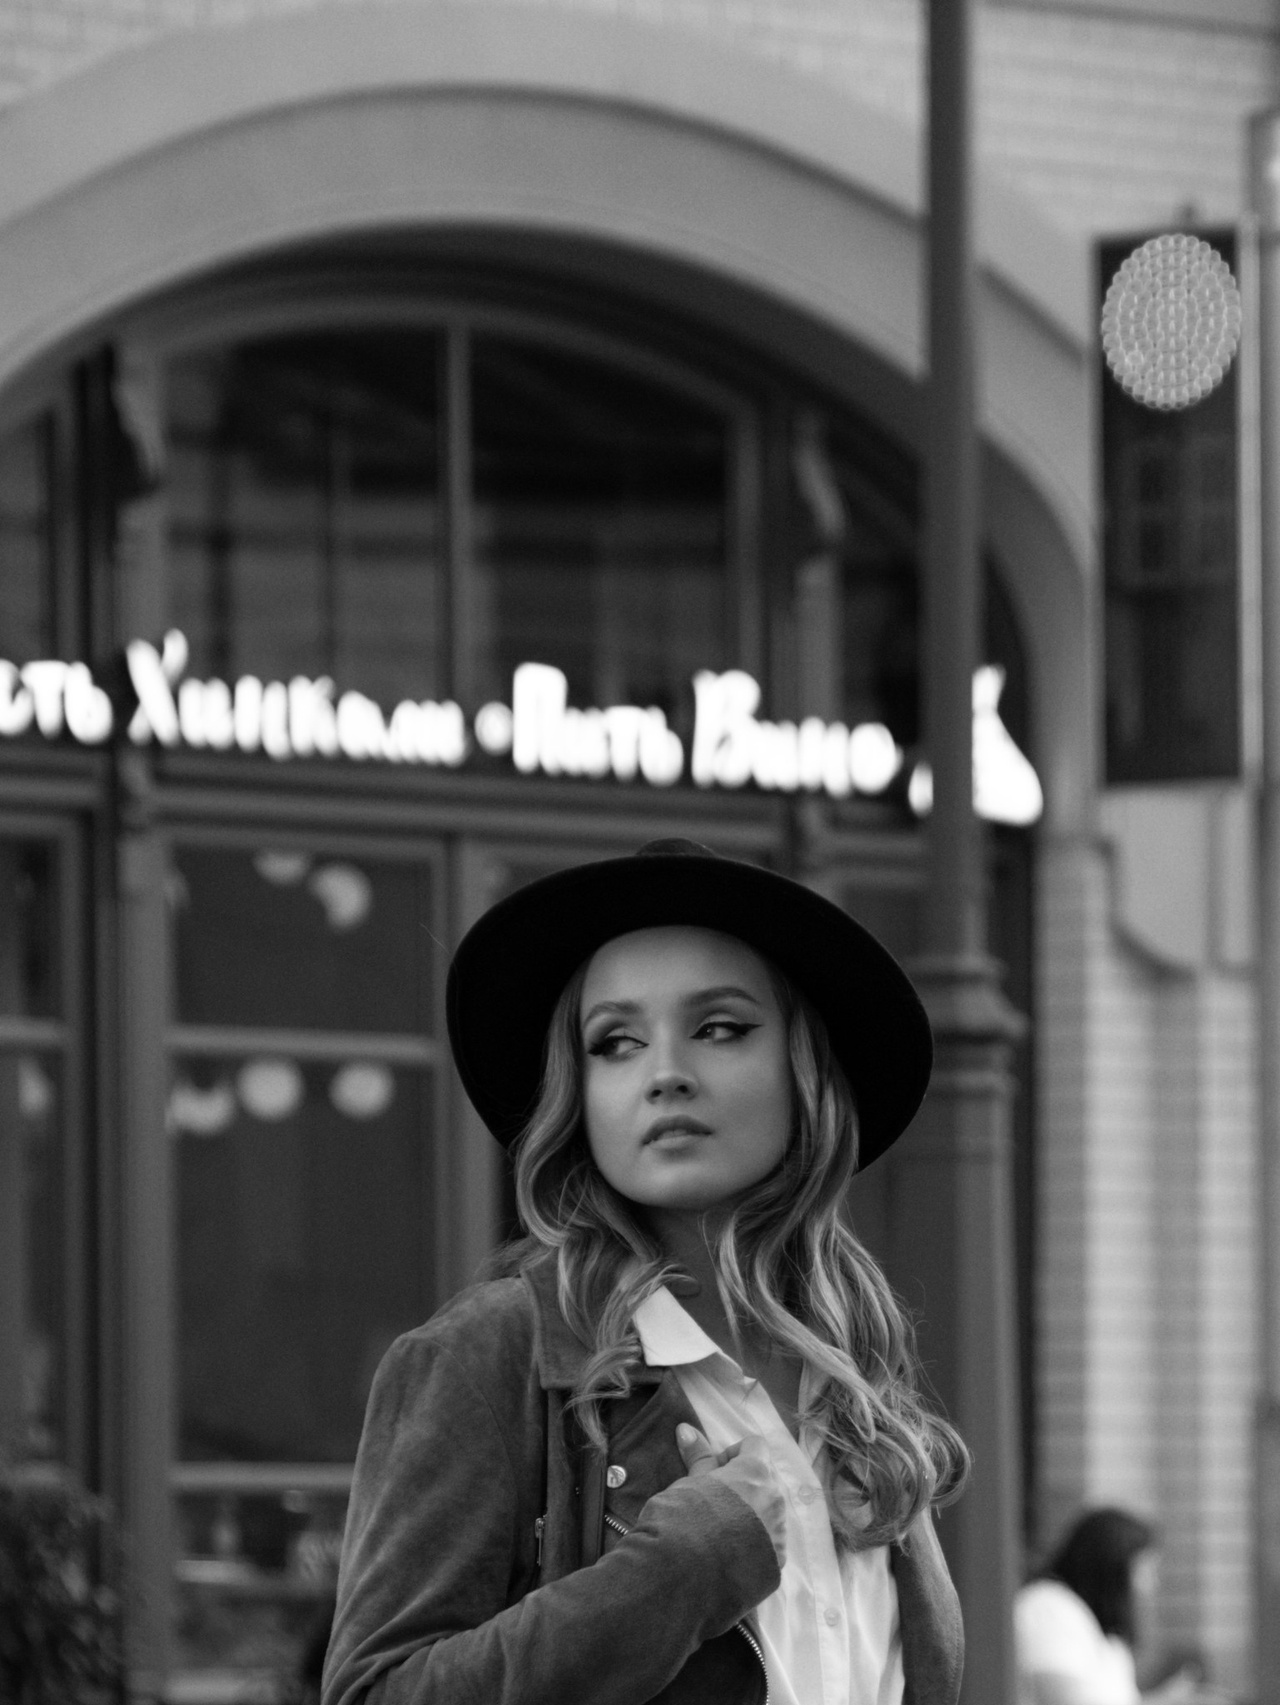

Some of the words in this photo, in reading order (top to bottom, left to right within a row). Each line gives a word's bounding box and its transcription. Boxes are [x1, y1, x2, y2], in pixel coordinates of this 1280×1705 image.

[127, 629, 465, 764] Хинкали
[513, 662, 684, 784] Пить
[692, 670, 901, 795] Вино
